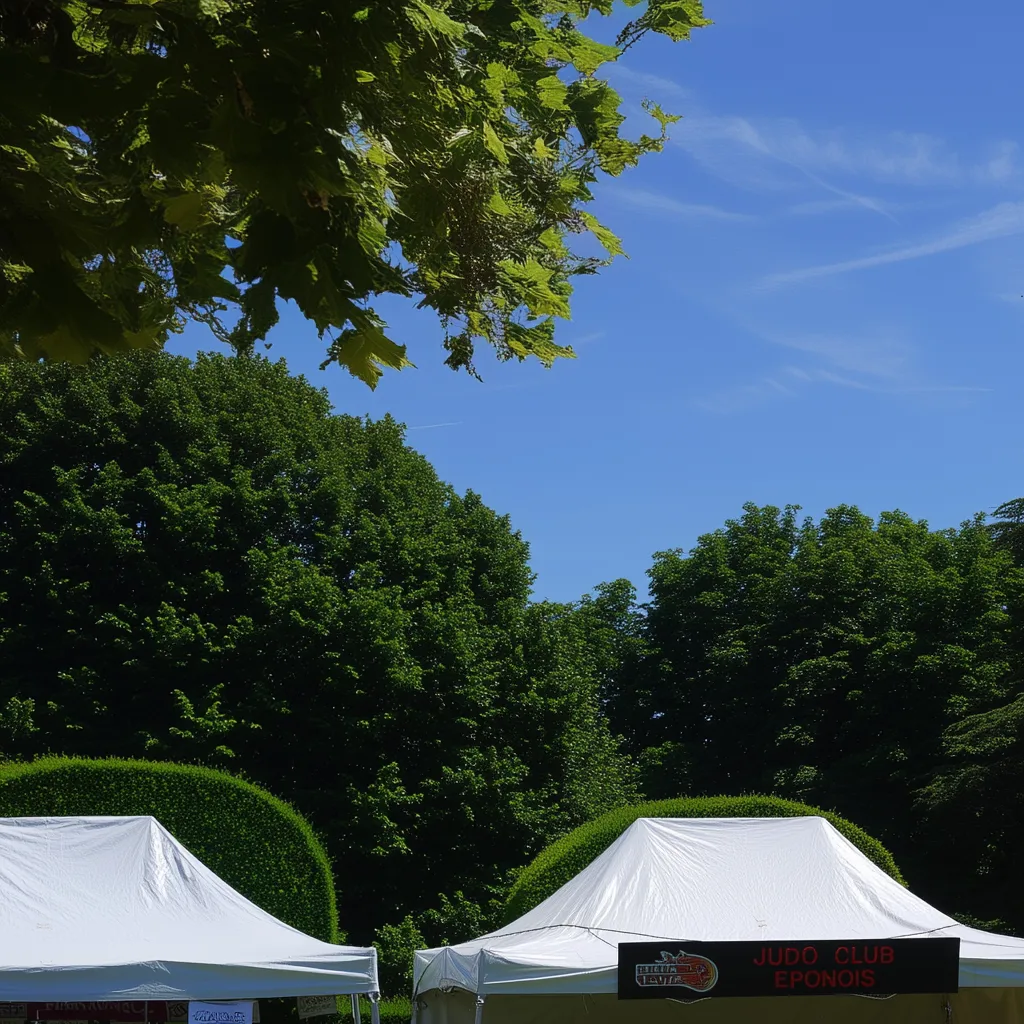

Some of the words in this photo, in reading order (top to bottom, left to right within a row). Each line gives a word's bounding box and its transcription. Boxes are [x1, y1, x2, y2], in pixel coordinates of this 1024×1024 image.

[753, 946, 818, 966] JUDO
[835, 946, 894, 964] CLUB
[774, 969, 876, 988] EPONOIS
